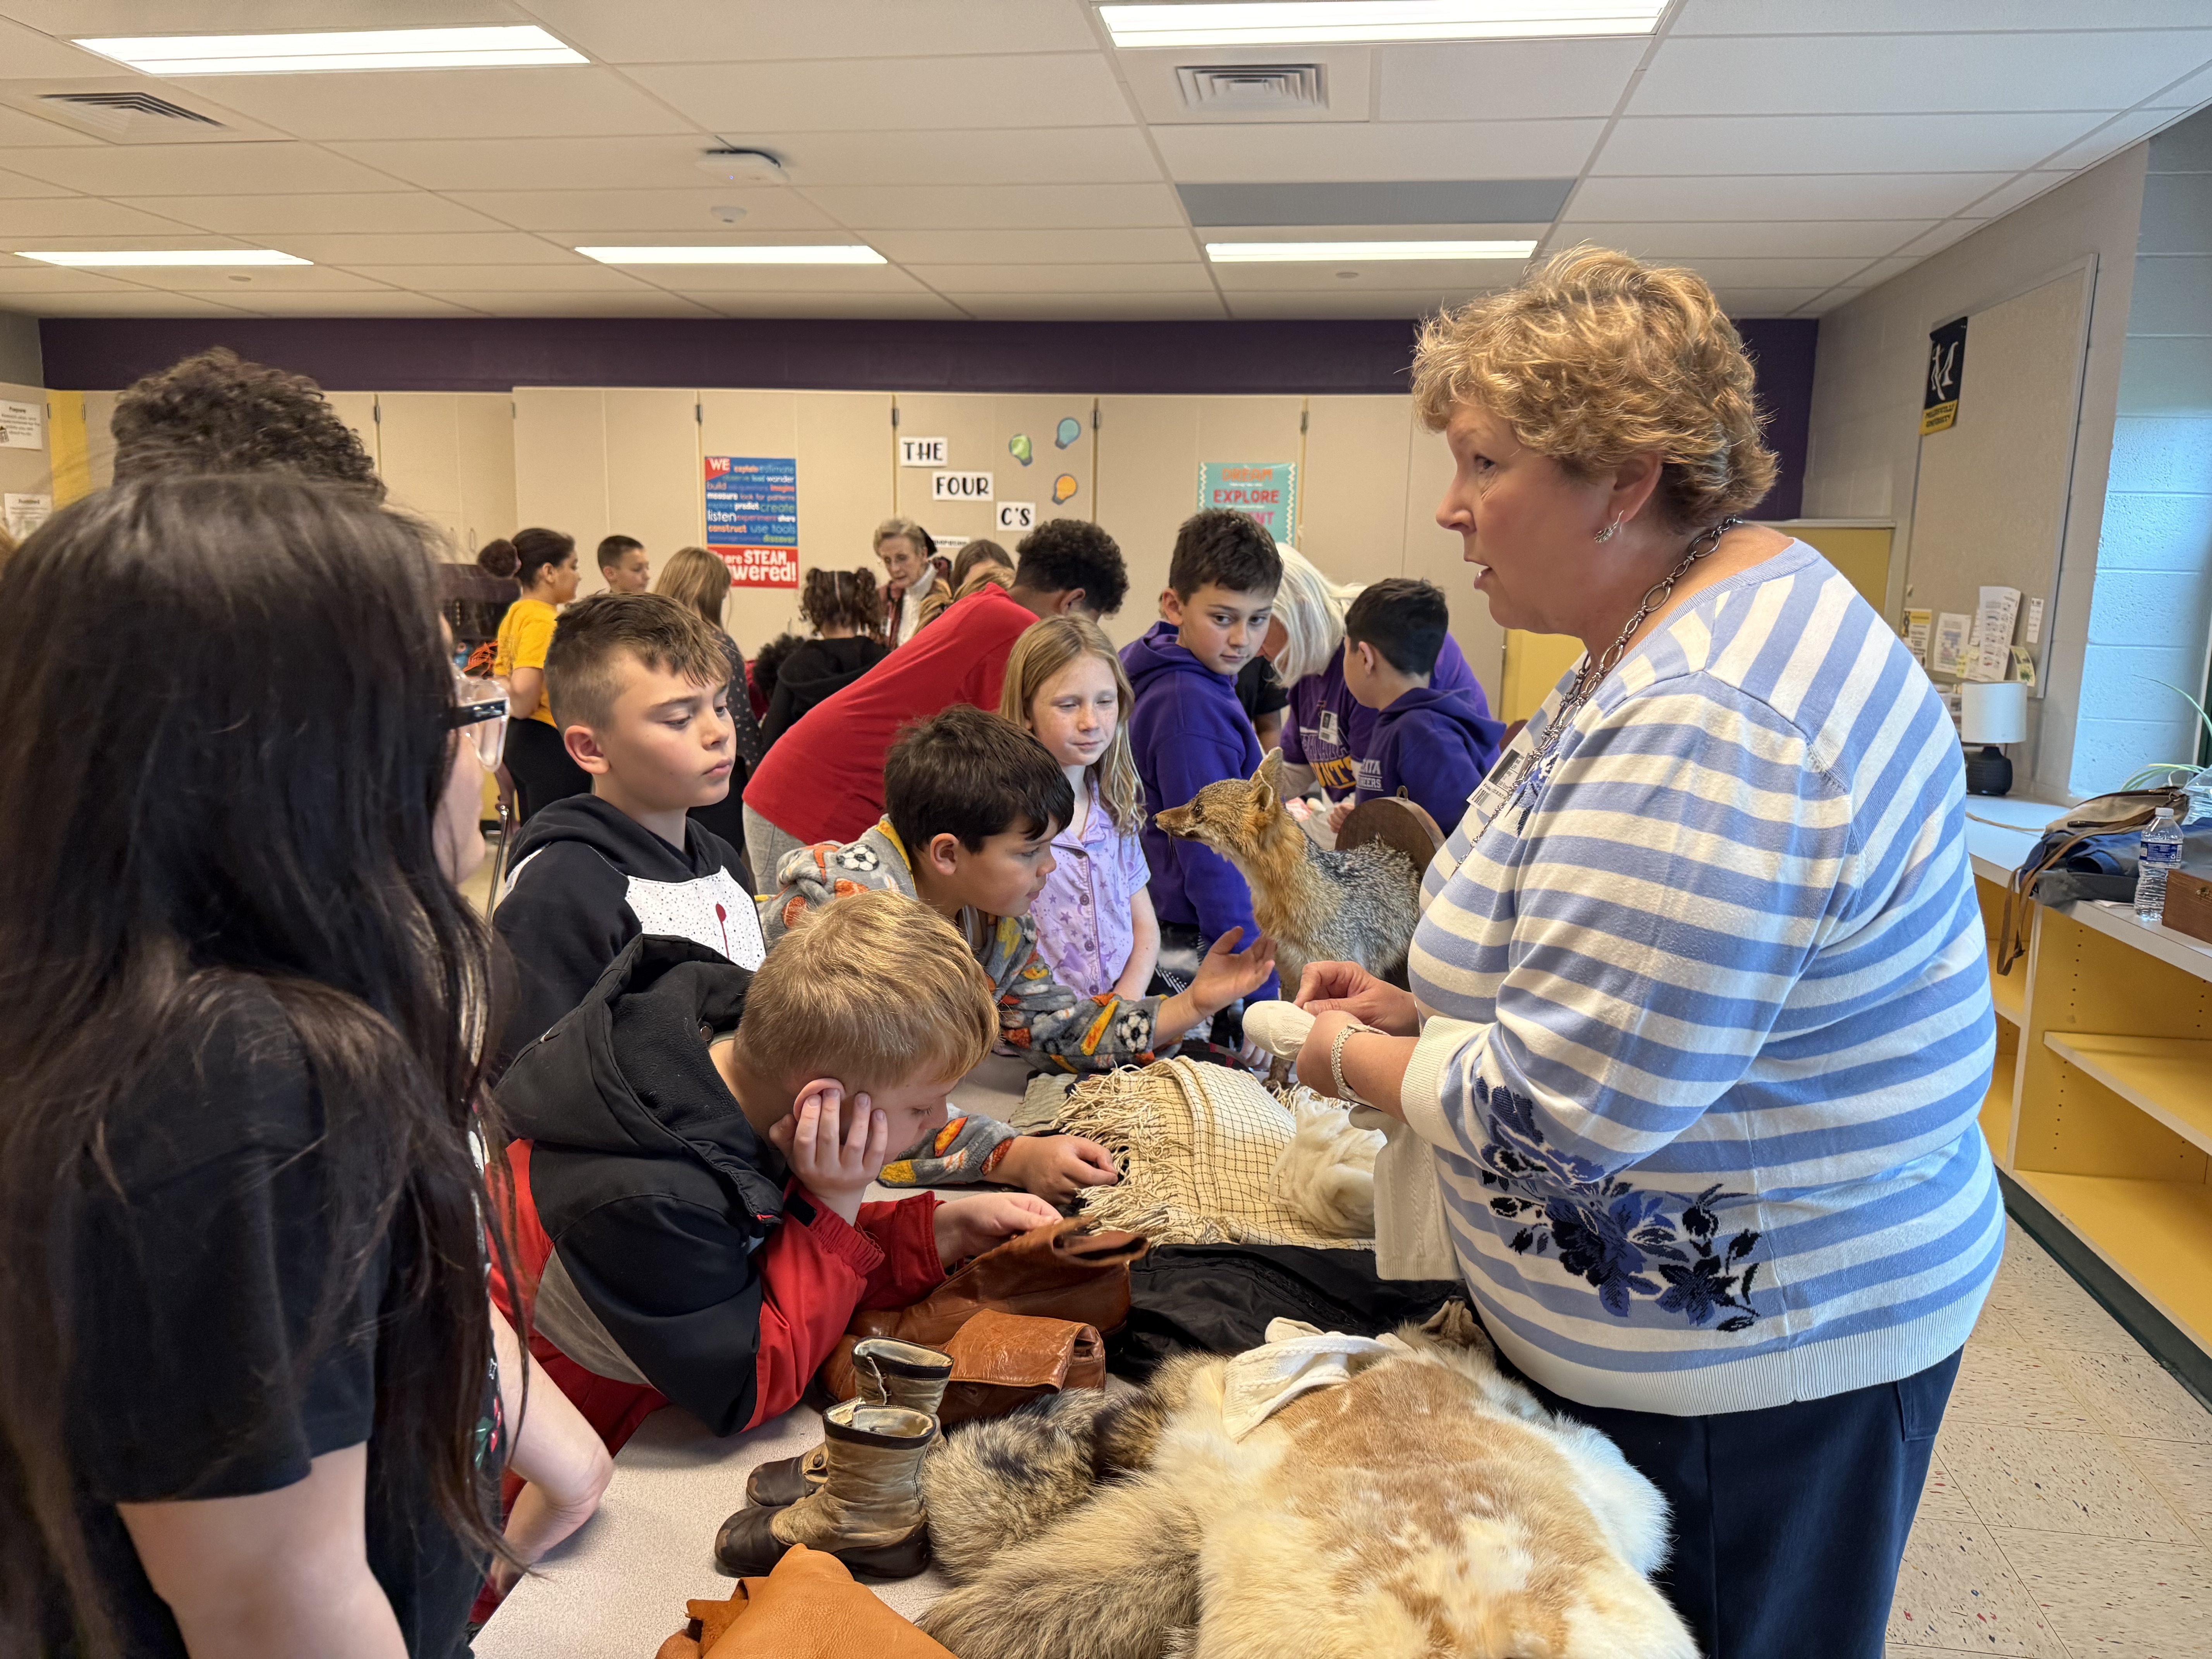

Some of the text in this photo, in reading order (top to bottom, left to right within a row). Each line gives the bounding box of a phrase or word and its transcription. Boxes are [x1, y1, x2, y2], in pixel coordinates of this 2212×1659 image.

[903, 442, 943, 461] THE
[709, 458, 730, 471] WE
[1222, 468, 1273, 481] DREAM
[707, 482, 727, 490] build
[936, 477, 989, 495] FOUR
[1214, 489, 1279, 504] EXPLORE
[734, 502, 759, 510] predict
[760, 503, 794, 513] create
[707, 510, 737, 522] listen
[1001, 508, 1030, 526] C'S
[708, 524, 747, 533] construct
[771, 524, 796, 534] tools
[725, 555, 743, 564] are
[744, 549, 787, 565] STEAM
[729, 561, 797, 582] wered!
